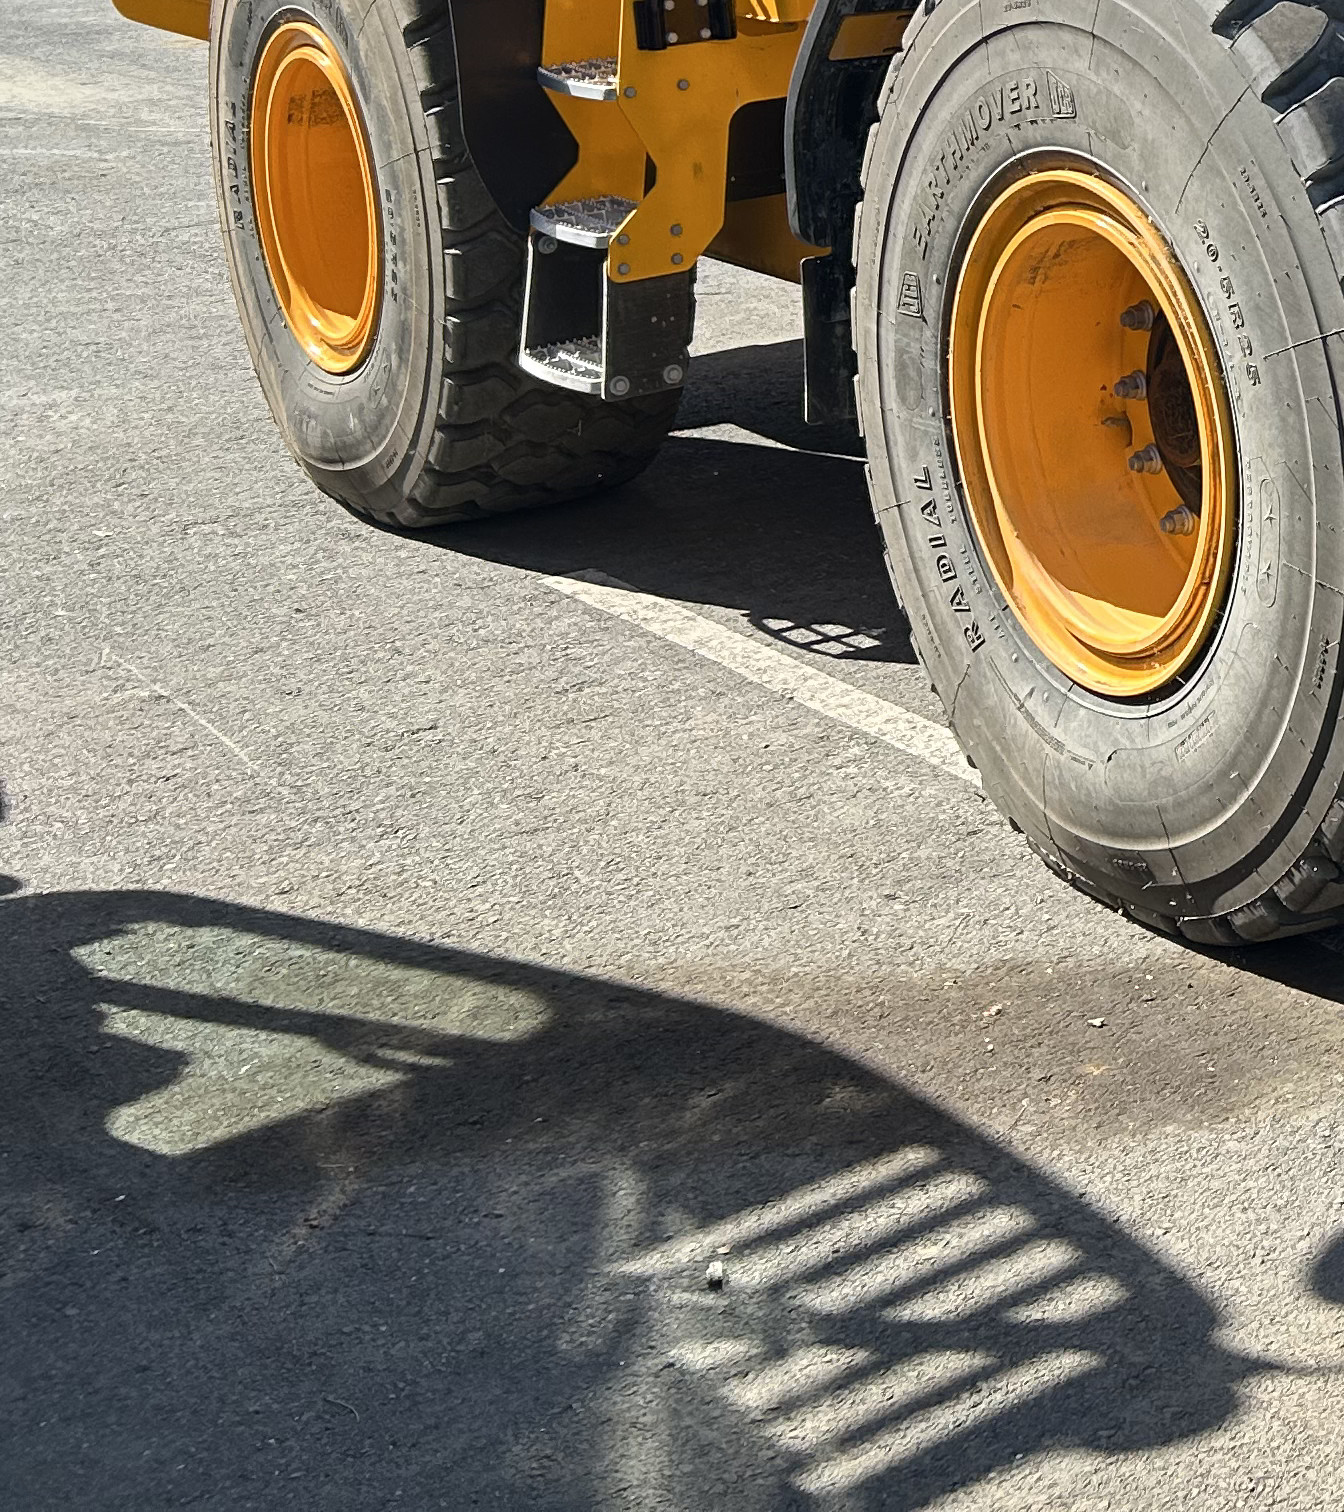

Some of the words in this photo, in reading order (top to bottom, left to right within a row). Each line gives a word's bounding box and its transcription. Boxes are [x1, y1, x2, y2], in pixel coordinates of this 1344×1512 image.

[225, 101, 245, 231] RADIAL
[912, 77, 1040, 260] EARTHMOVER
[1194, 218, 1261, 386] 20.5R25
[913, 464, 986, 653] RADIAL
